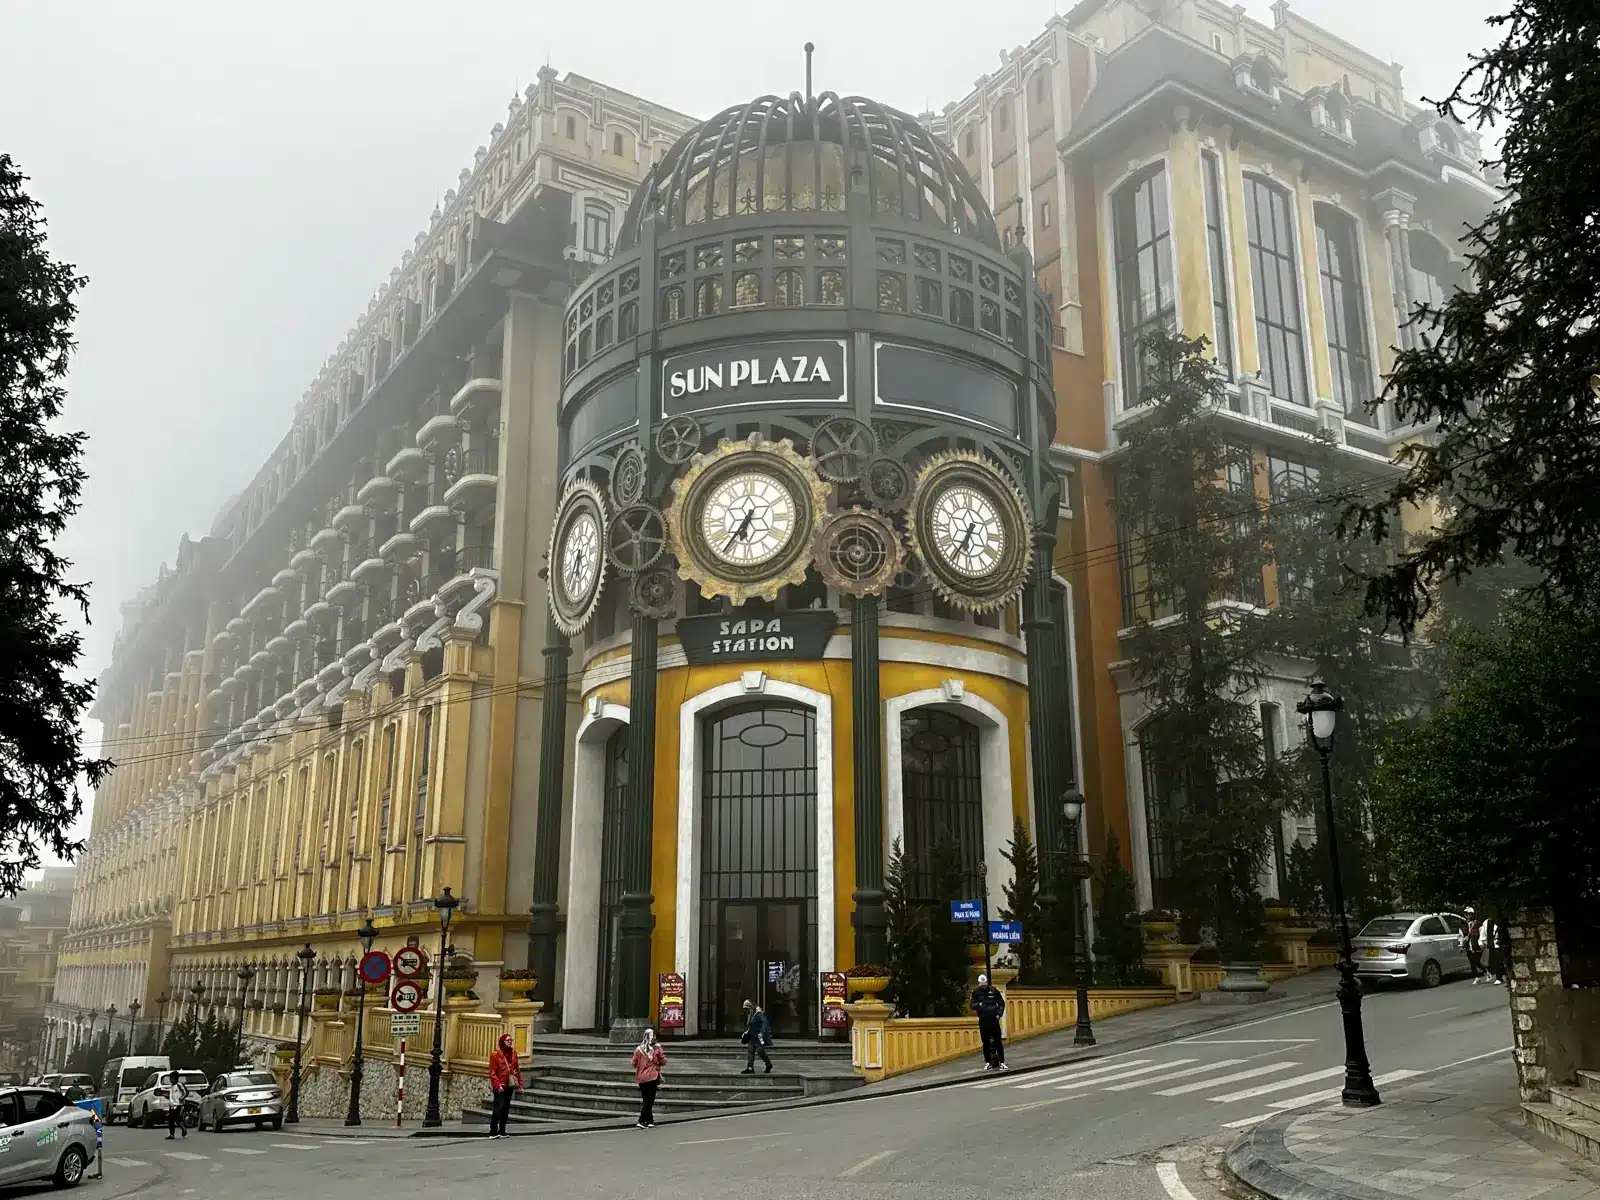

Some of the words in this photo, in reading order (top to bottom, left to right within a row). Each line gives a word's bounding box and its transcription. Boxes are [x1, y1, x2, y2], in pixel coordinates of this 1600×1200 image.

[670, 363, 724, 398] SUN
[730, 355, 832, 387] PLAZA
[720, 618, 782, 636] SAPA
[712, 636, 794, 654] STATION
[1009, 931, 1020, 940] LIÊN
